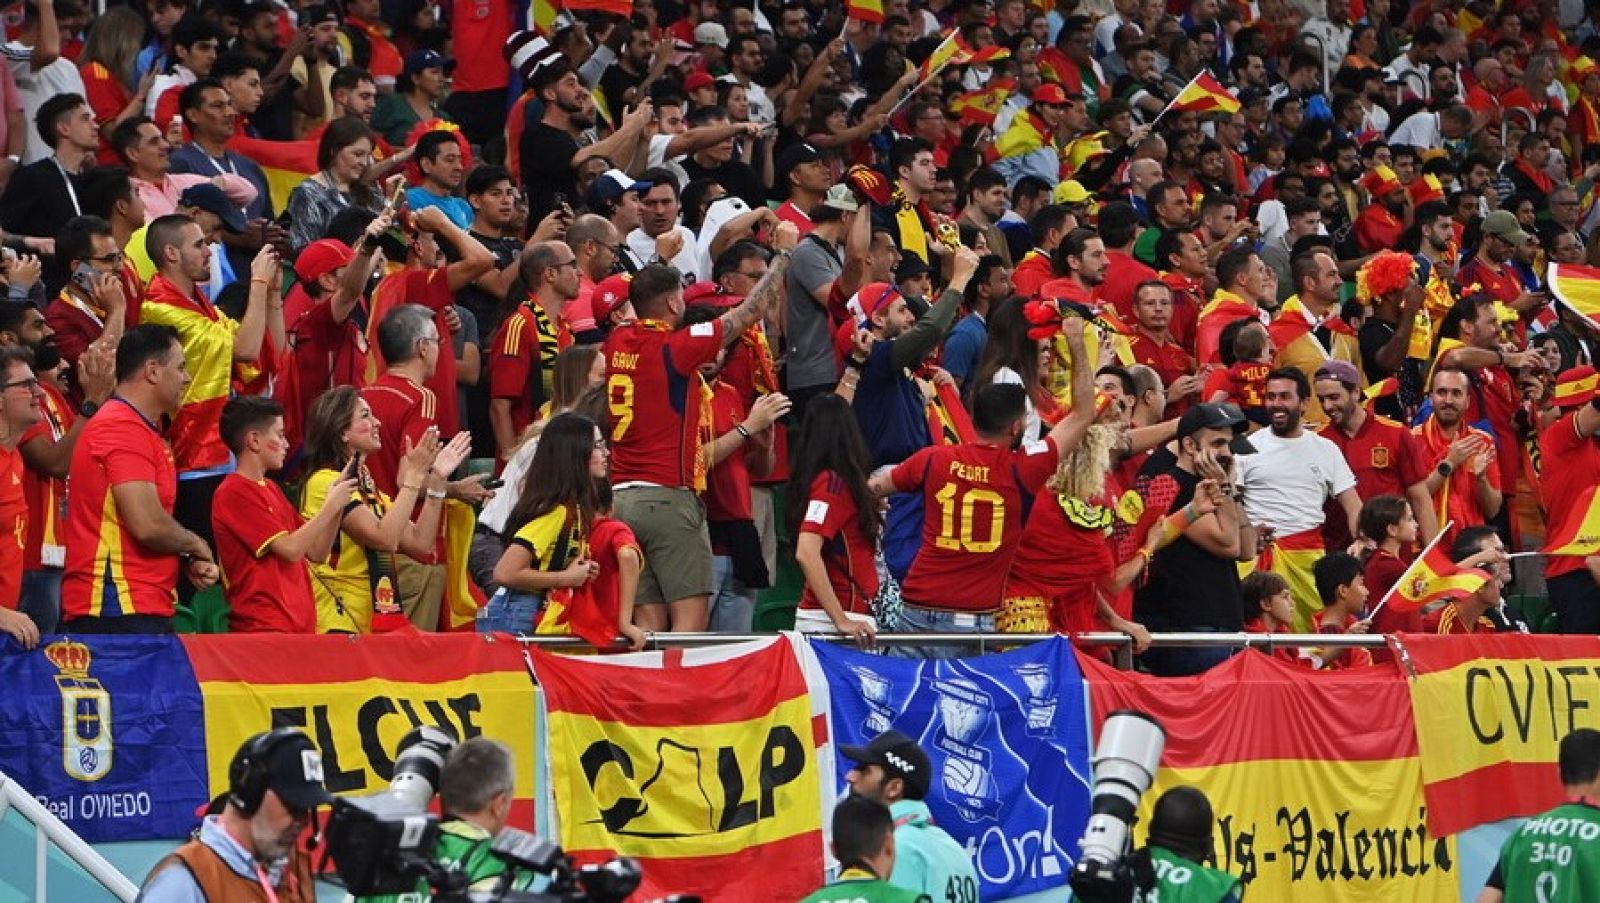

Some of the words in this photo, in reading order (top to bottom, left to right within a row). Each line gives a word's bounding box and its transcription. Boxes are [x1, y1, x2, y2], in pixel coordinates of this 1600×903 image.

[608, 373, 635, 442] 9
[935, 482, 1005, 553] 10
[81, 792, 151, 820] OVIEDO
[1521, 817, 1599, 841] PHOTO
